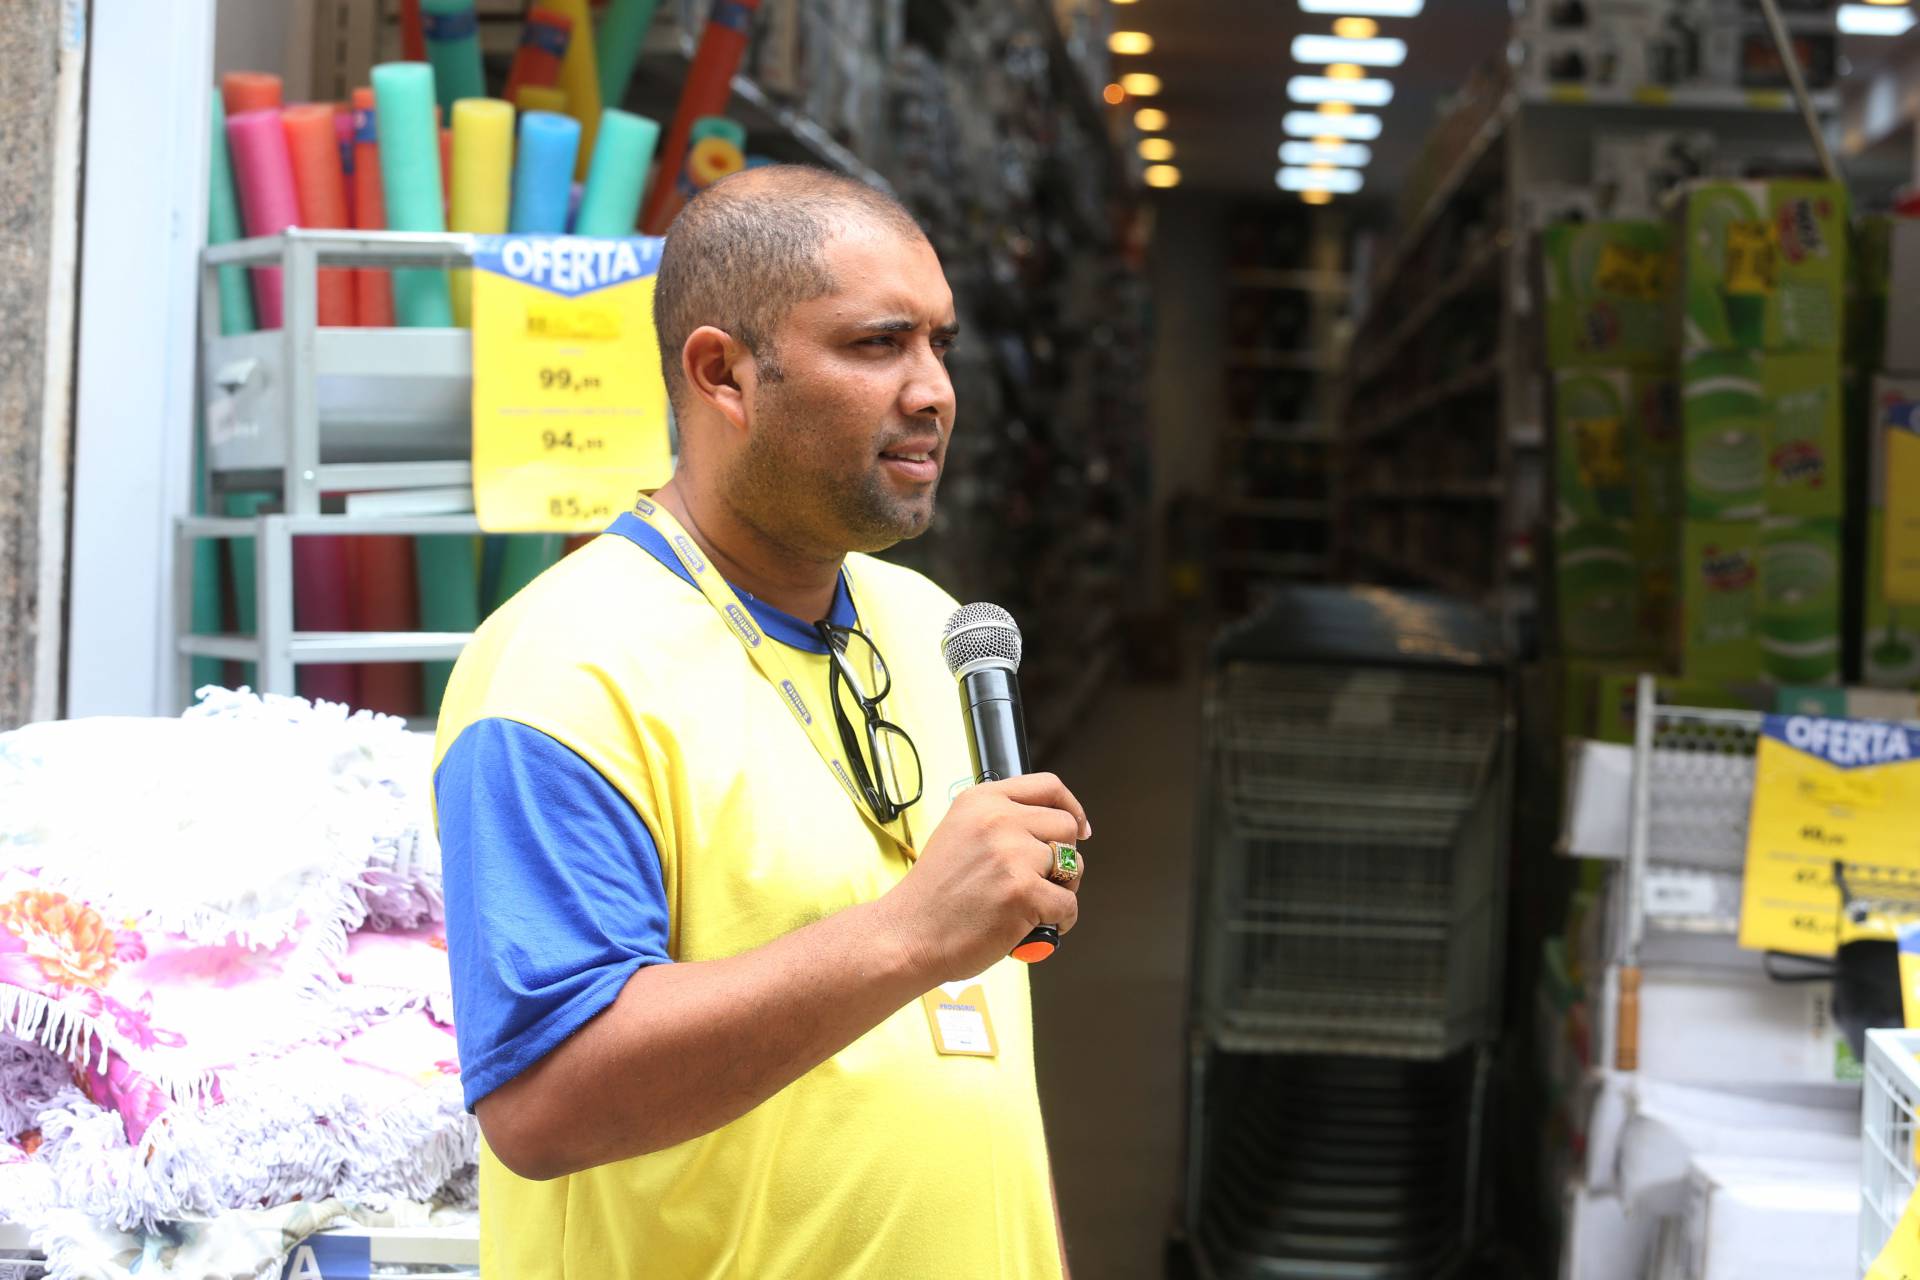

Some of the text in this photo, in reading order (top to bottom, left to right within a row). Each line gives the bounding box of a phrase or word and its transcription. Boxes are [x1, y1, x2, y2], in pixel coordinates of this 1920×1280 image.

[502, 239, 639, 290] OFERTA
[730, 606, 759, 643] Santista
[785, 684, 811, 721] Santista
[1785, 716, 1910, 766] OFERTA
